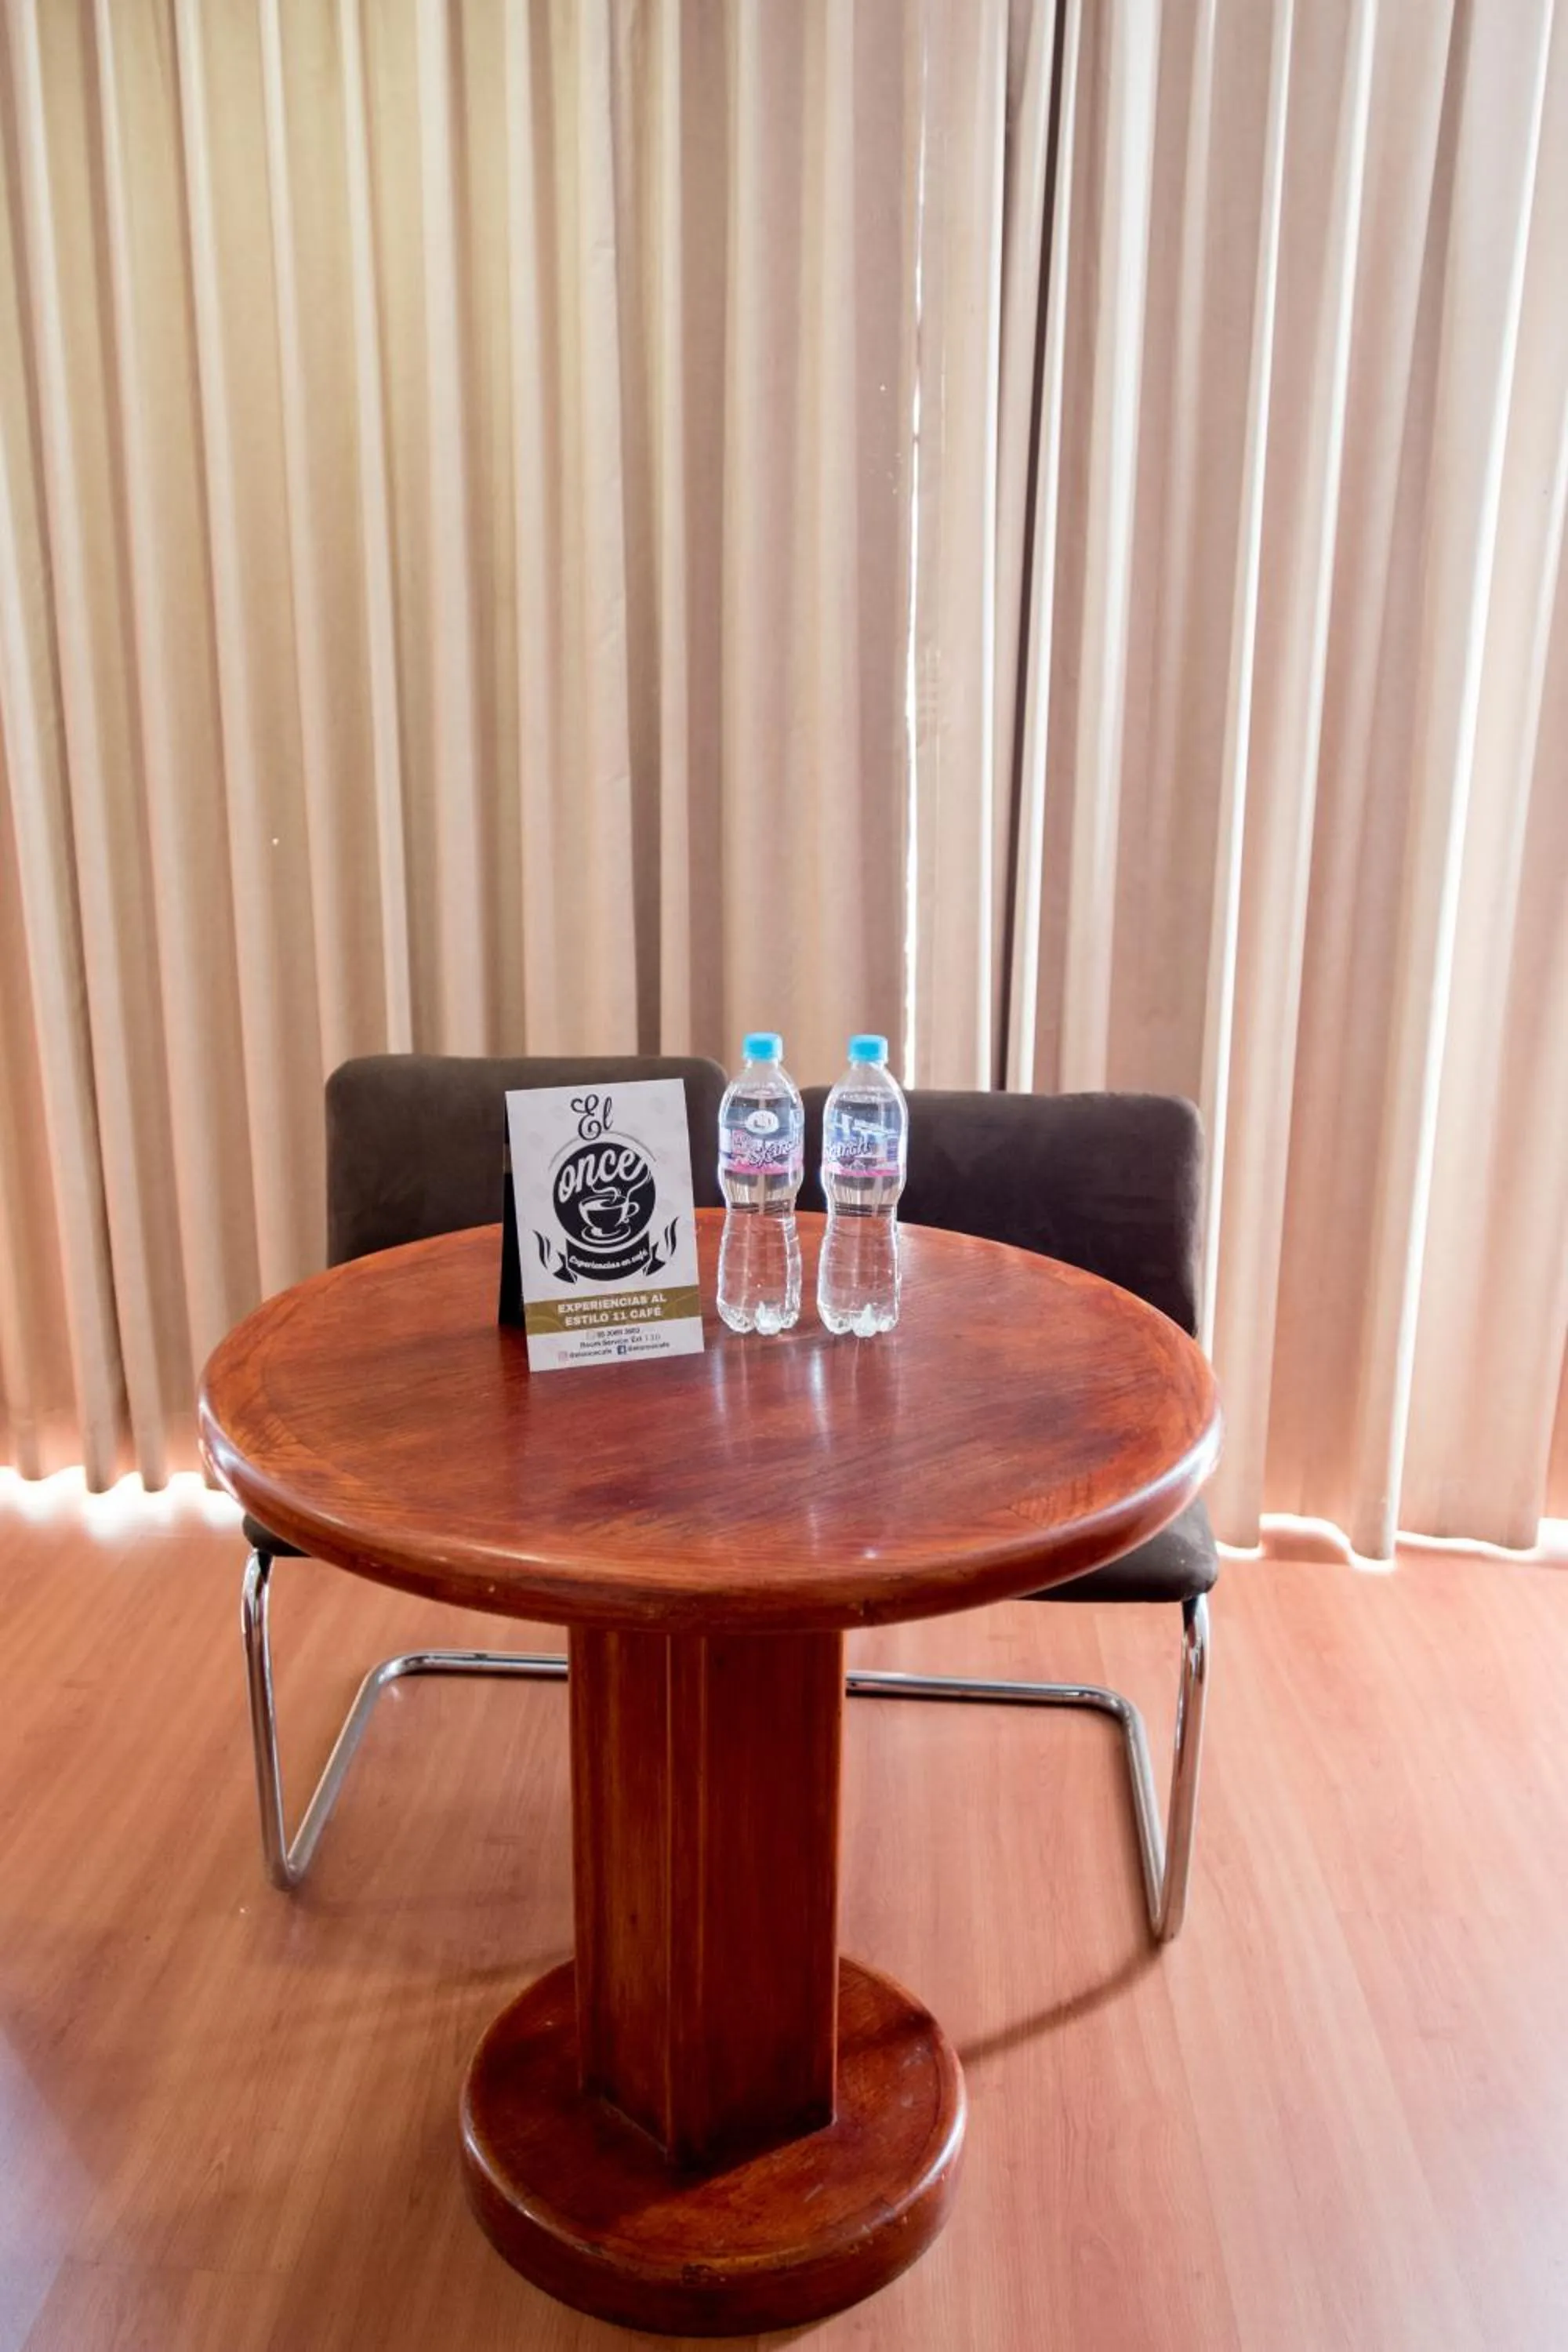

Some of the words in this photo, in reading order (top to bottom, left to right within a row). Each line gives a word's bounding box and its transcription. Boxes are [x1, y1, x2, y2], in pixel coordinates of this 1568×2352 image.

[571, 1094, 613, 1141] El
[558, 1149, 644, 1203] once
[557, 1298, 647, 1313] EXPERIENCIAS
[652, 1294, 666, 1303] AL
[565, 1311, 609, 1327] ESTILO
[613, 1312, 627, 1321] 11
[602, 1338, 629, 1347] Service
